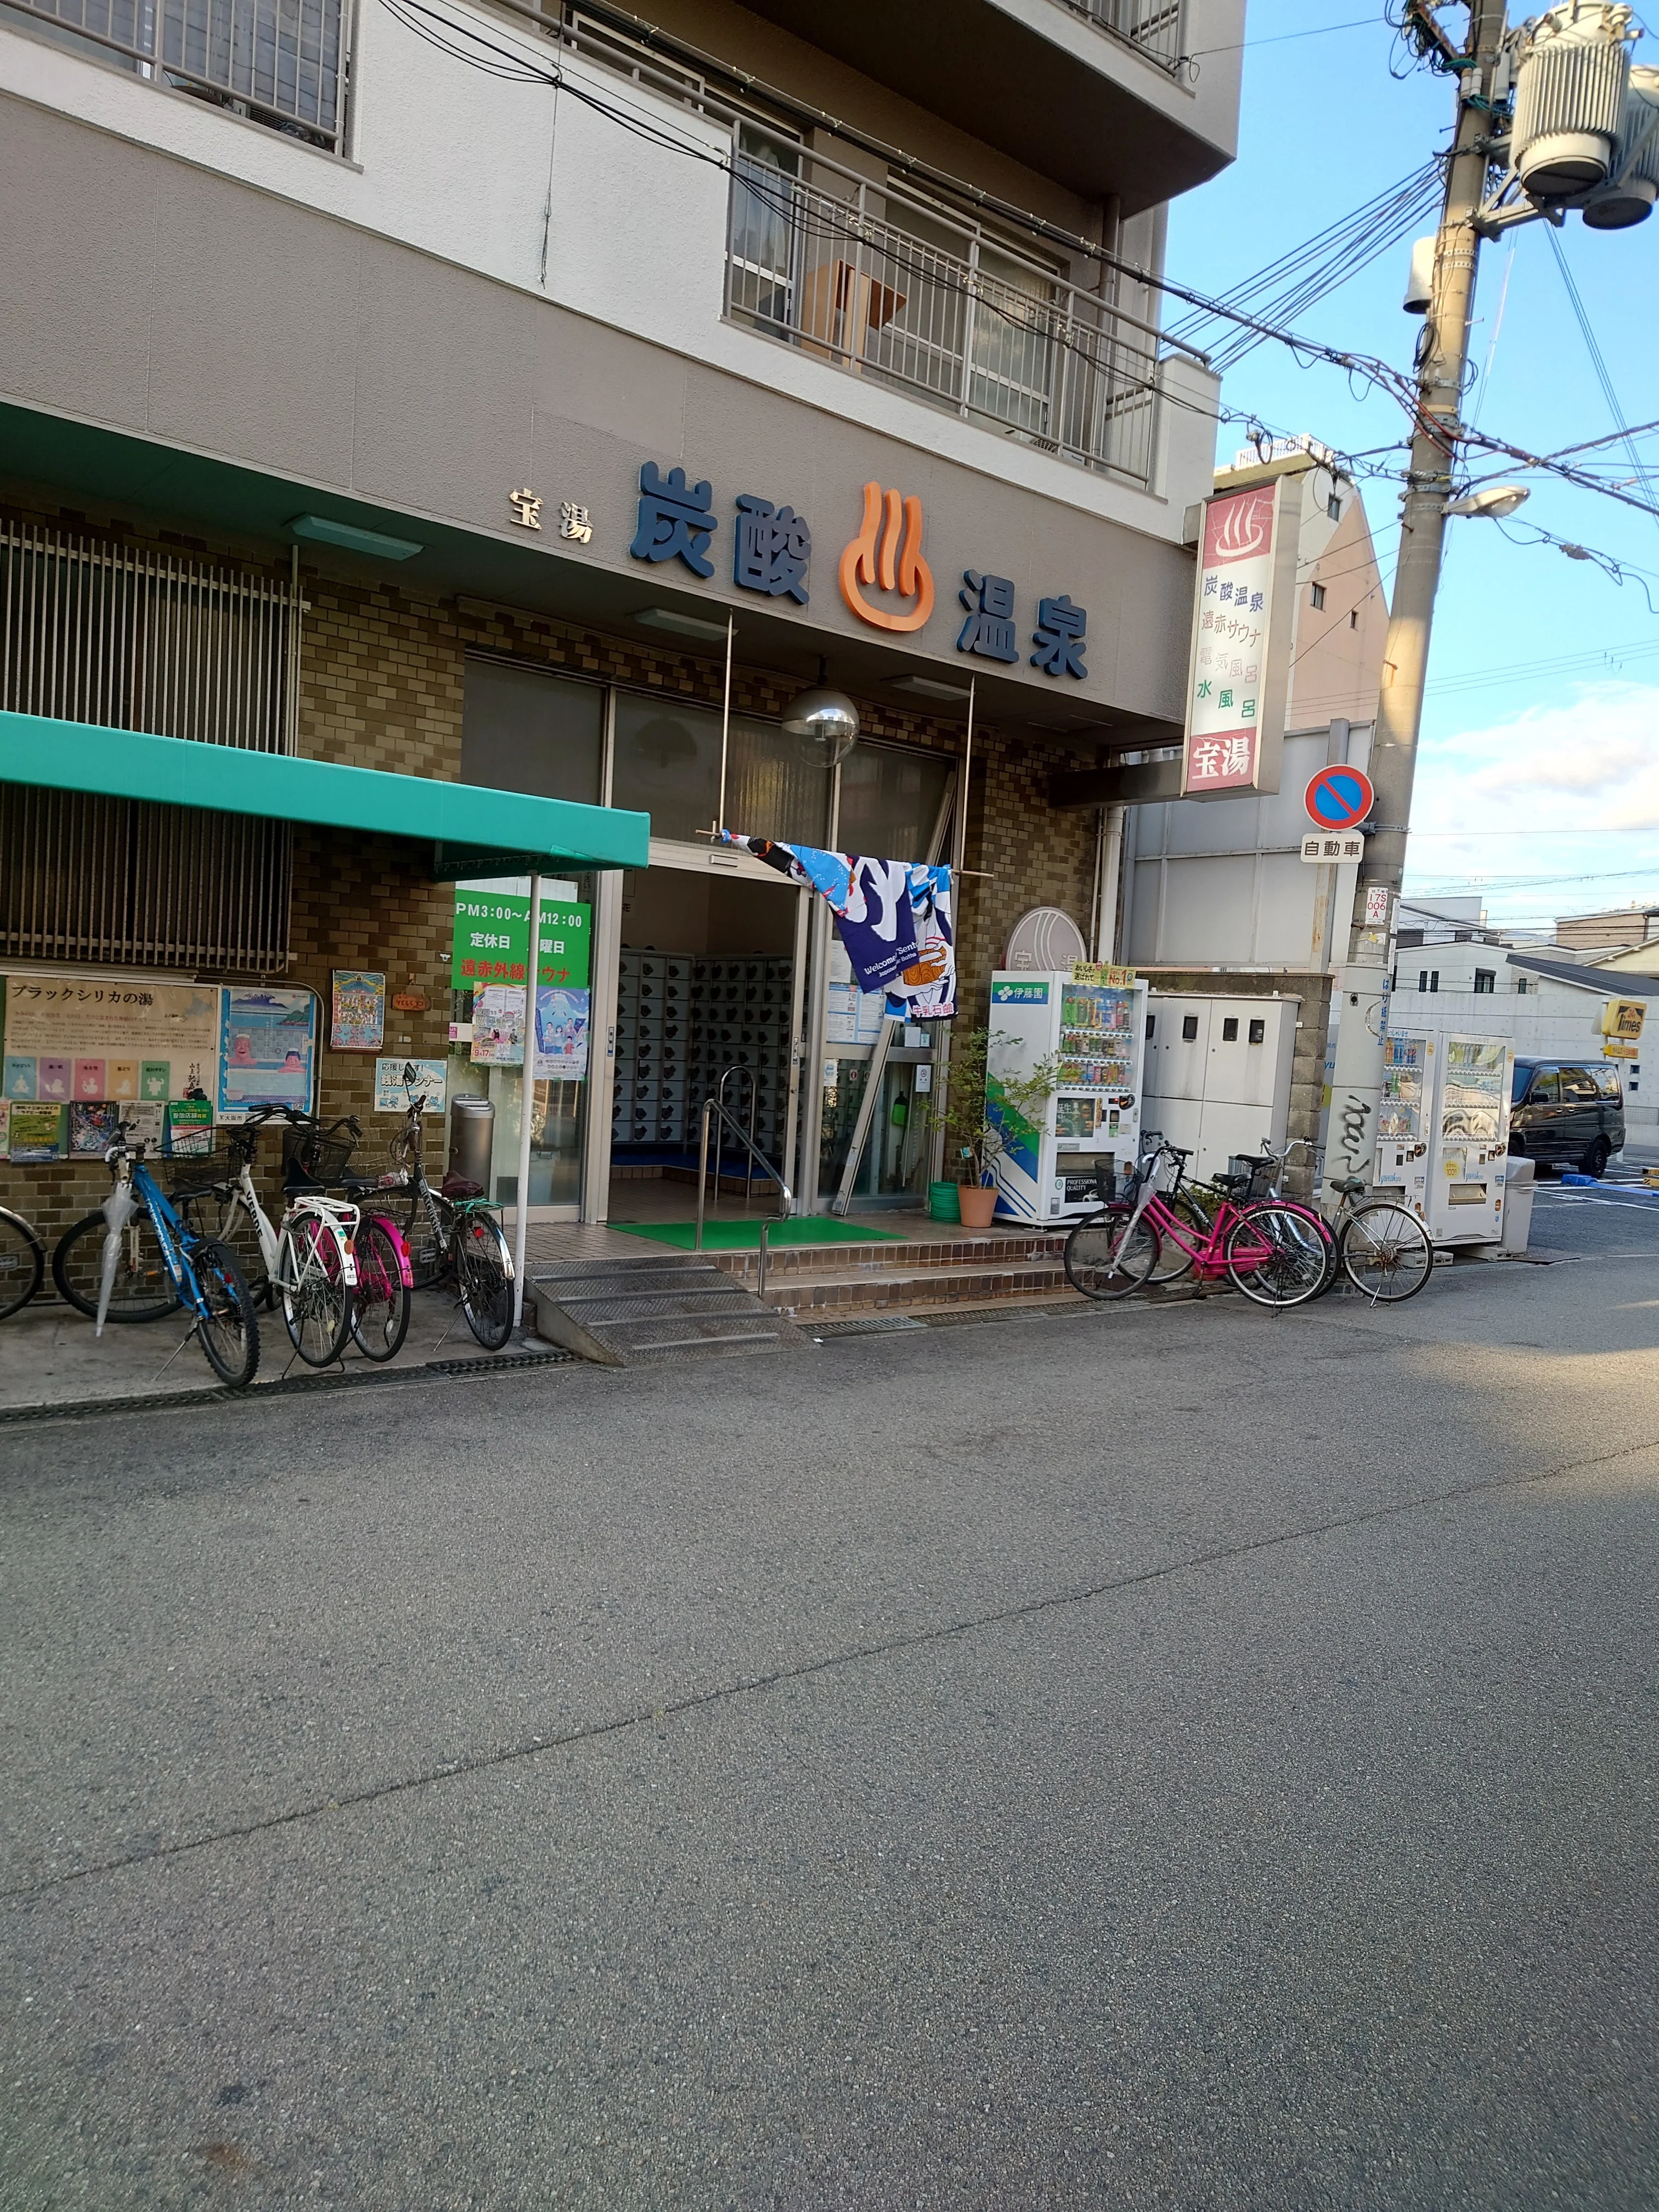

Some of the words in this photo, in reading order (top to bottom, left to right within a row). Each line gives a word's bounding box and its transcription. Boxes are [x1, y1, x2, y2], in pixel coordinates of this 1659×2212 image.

[509, 487, 593, 544] 宝湯
[629, 460, 811, 605] 炭酸
[956, 568, 1088, 680] 温泉
[1204, 575, 1264, 613] 炭酸温泉
[1201, 611, 1261, 648] 遠赤サウナ
[1200, 647, 1258, 684] 電気風呂
[1197, 679, 1256, 718] 水風呂
[1192, 736, 1250, 781] 宝湯
[1304, 840, 1361, 856] 自動車
[1367, 902, 1386, 911] 006
[1370, 894, 1387, 902] 17S
[1373, 910, 1379, 918] A
[470, 932, 511, 950] 定休日
[526, 939, 565, 955] 曜日
[864, 955, 896, 975] Welcome
[901, 952, 917, 962] Baths
[460, 958, 571, 983] 遠赤外線ウナ
[11, 985, 154, 1006] ブラックシリカの湯
[1014, 987, 1043, 999] 伊藤園
[1378, 978, 1390, 1046] はり紙禁止
[381, 1063, 424, 1071] 応援しす!
[1380, 1172, 1402, 1185] yamakyu
[246, 1190, 263, 1238] VERDE
